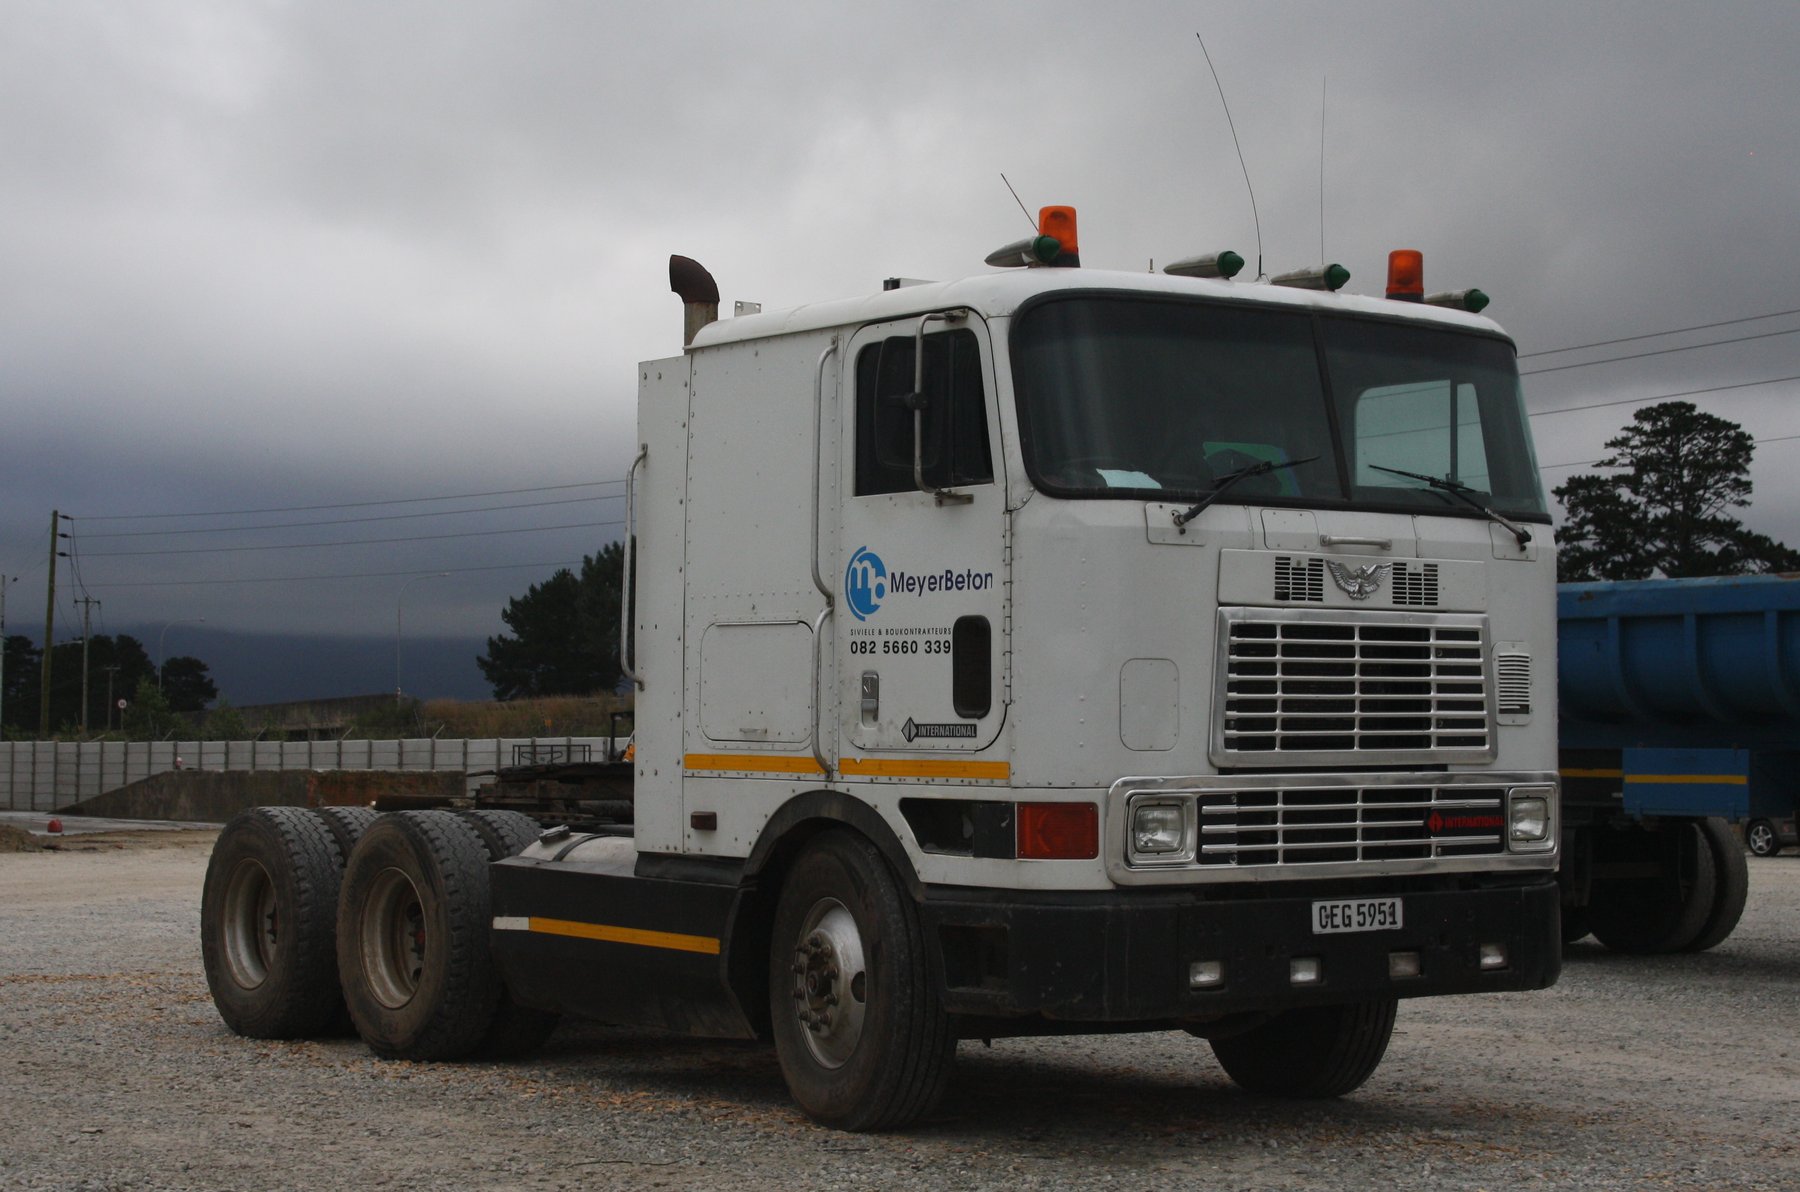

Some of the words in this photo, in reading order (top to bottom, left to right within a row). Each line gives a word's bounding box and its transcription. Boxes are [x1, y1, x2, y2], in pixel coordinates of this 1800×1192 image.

[890, 568, 993, 597] MeyerBeton
[850, 628, 875, 636] SIVIELE
[878, 628, 882, 636] &
[885, 627, 952, 636] BOUKONTRAKTEURS
[850, 640, 876, 654] 082
[883, 640, 918, 654] 5660
[924, 640, 951, 653] 339
[918, 725, 976, 737] INTERNATIONAL
[1319, 904, 1352, 929] CEG
[1357, 901, 1398, 927] 5951
